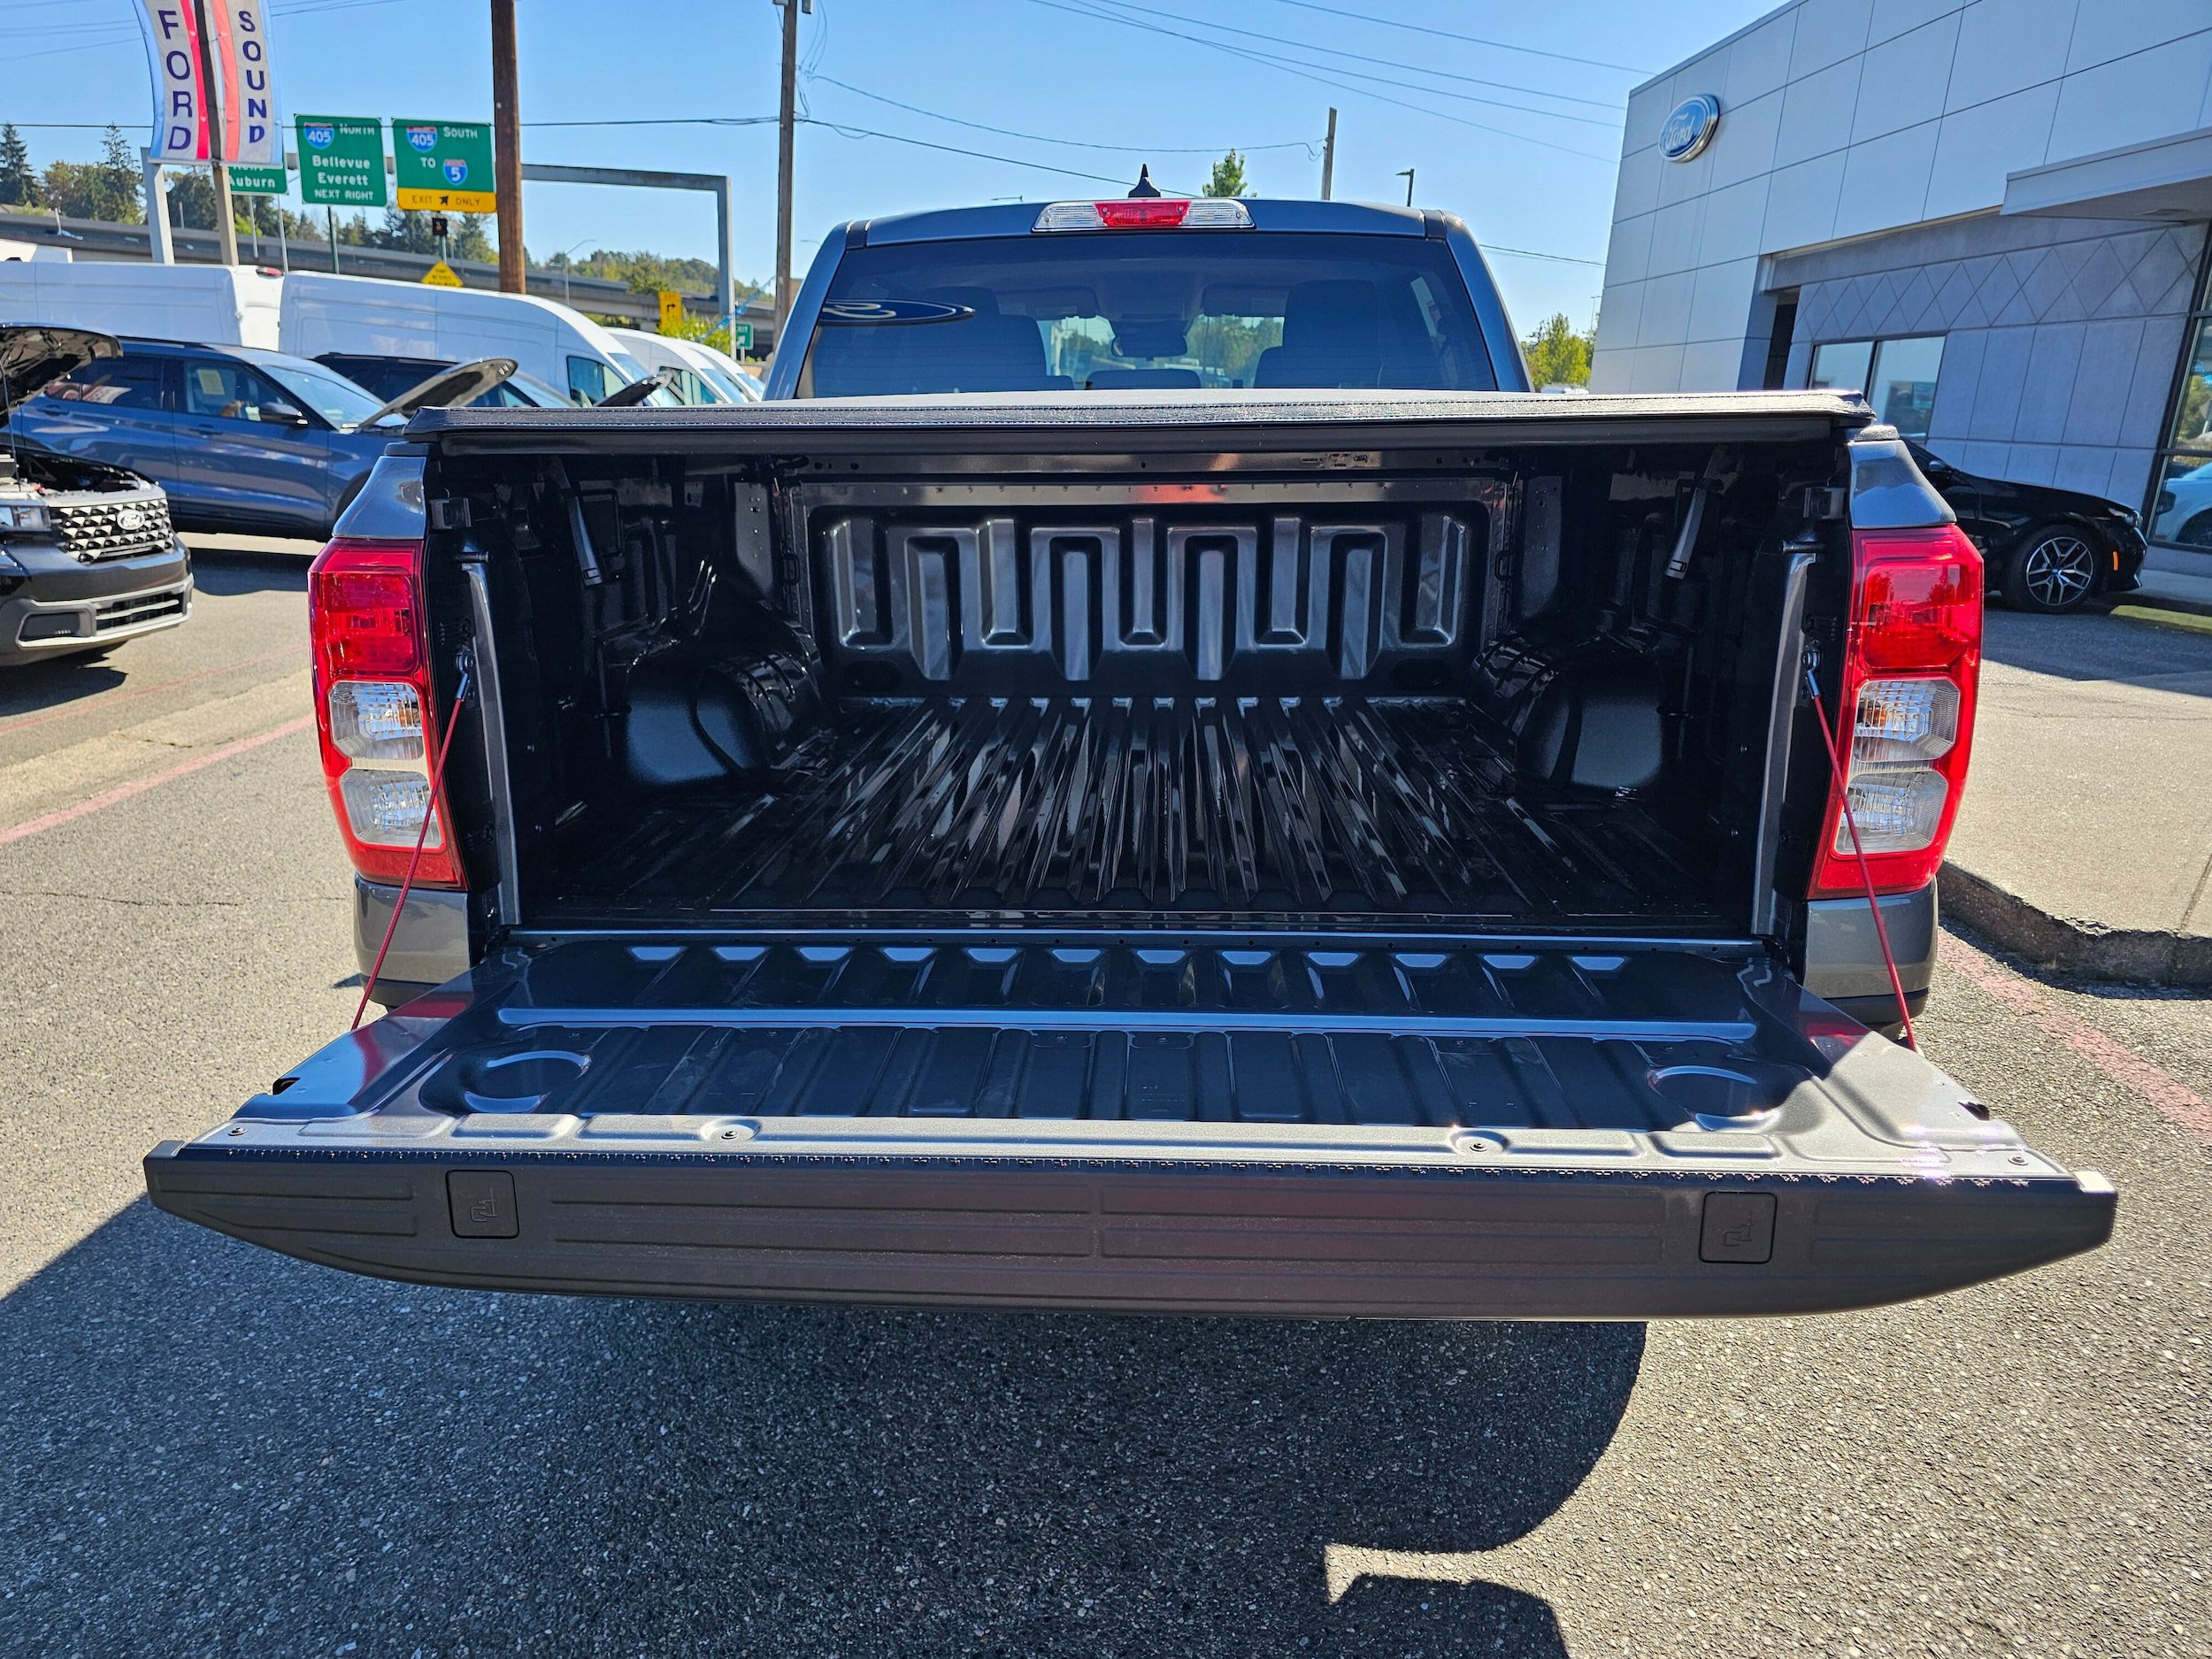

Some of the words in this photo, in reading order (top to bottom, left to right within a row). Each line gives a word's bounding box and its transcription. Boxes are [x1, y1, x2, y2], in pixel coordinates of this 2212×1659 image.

[157, 10, 193, 150] FORD
[238, 11, 267, 143] SOUND
[308, 130, 331, 143] 405
[339, 123, 375, 135] NORTH
[411, 134, 434, 147] 405
[443, 127, 478, 139] SOUTH
[1664, 111, 1695, 153] Ford
[312, 155, 370, 169] Bellevue
[420, 157, 436, 169] TO
[450, 166, 461, 182] 5
[318, 171, 368, 186] Everett
[314, 188, 340, 199] NEXT
[344, 189, 373, 201] RIGHT
[412, 195, 433, 204] EXIT
[456, 197, 480, 206] ONLY
